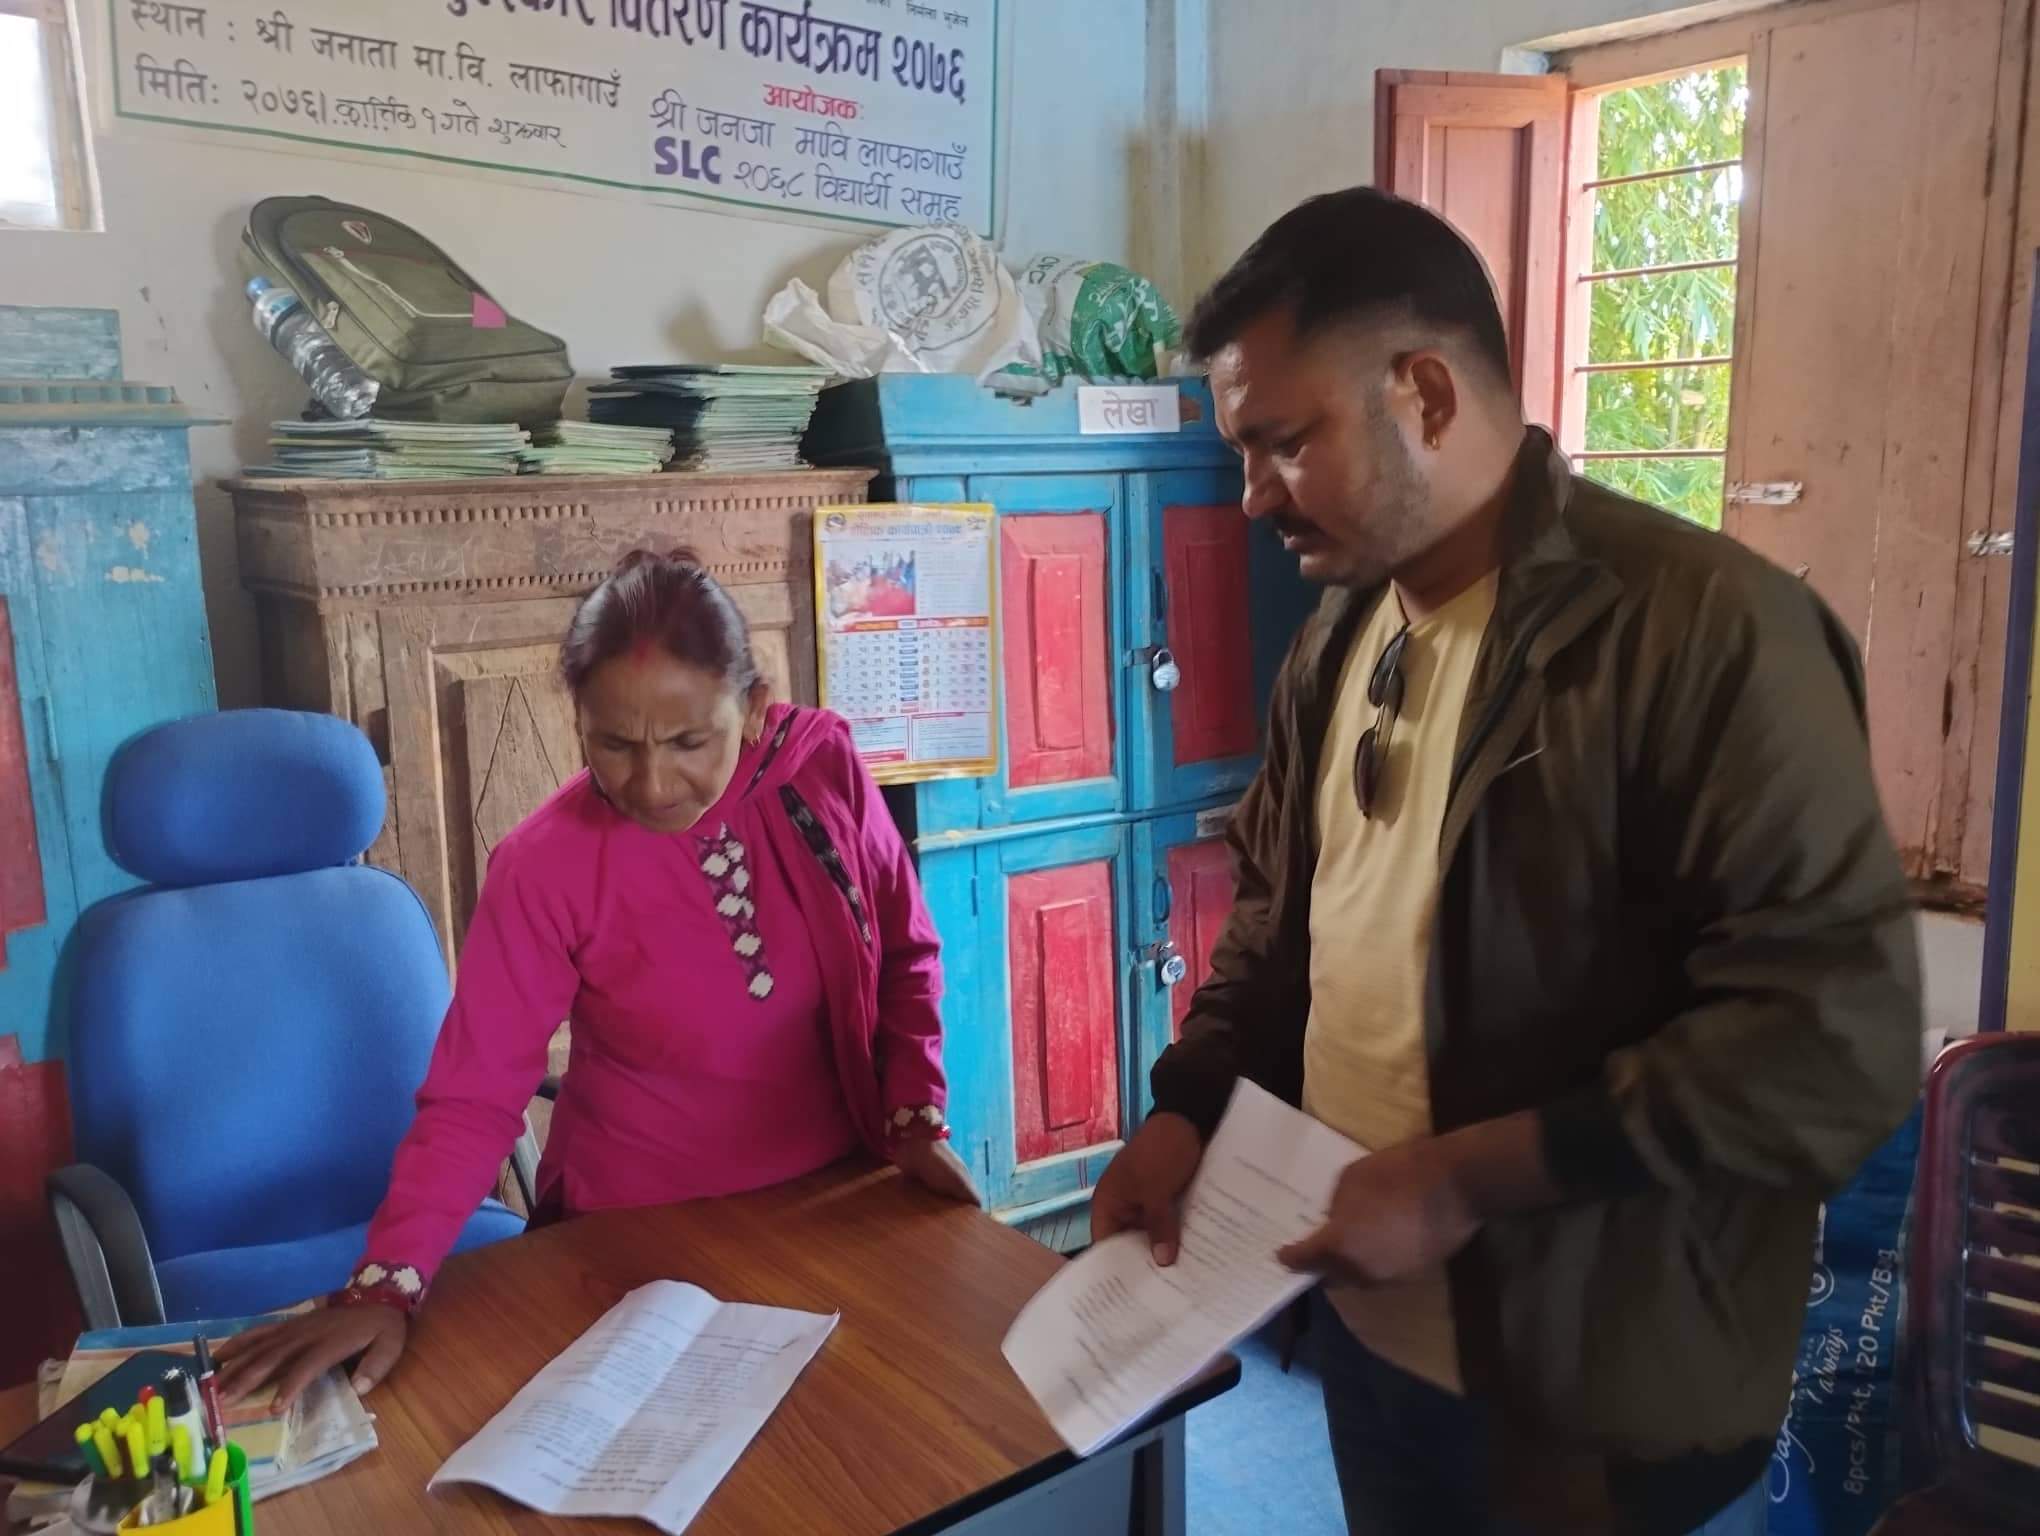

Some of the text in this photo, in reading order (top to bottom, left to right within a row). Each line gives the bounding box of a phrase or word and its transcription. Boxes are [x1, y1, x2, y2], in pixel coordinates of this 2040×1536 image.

[256, 11, 294, 54] श्री
[310, 27, 397, 70] जनाता
[741, 0, 881, 82] कार्यक्रम
[893, 35, 966, 104] २०७६
[649, 88, 688, 132] श्री
[654, 135, 721, 185] SLC
[1102, 389, 1159, 430] लेखा
